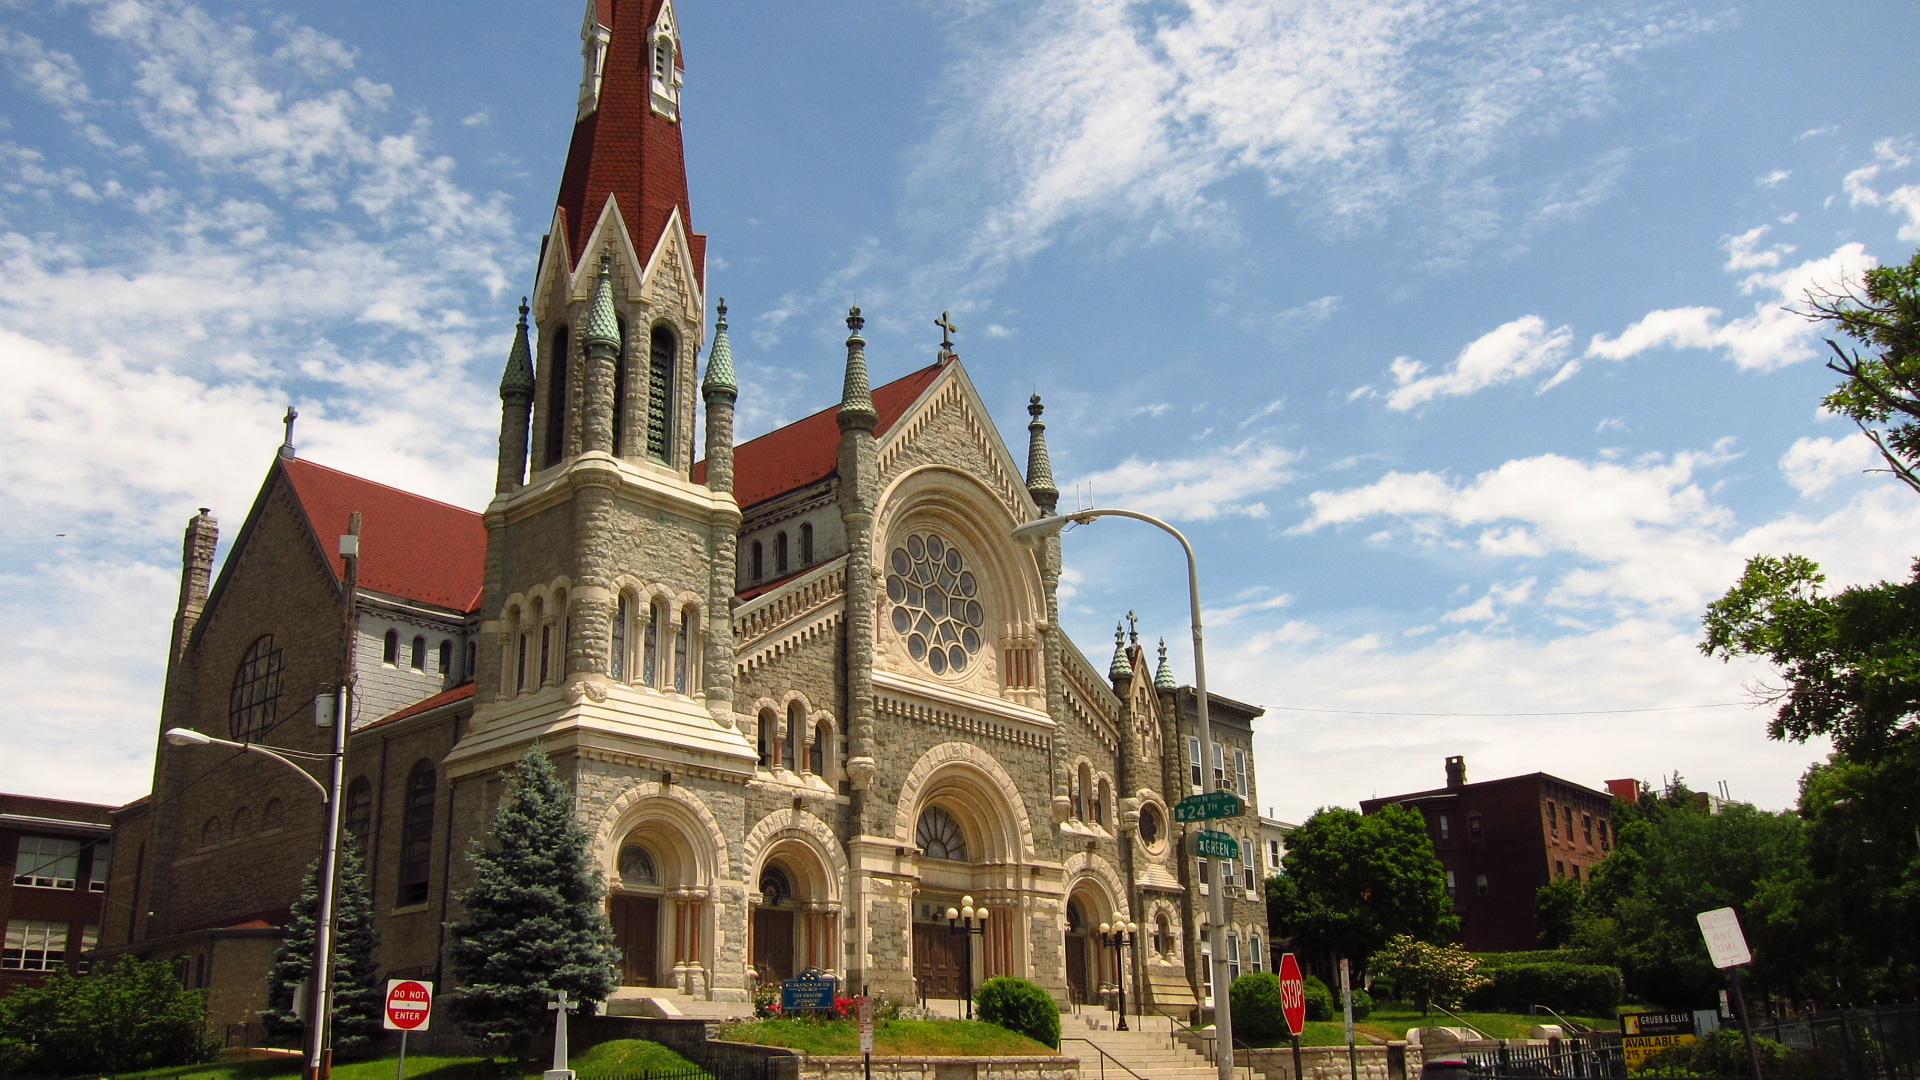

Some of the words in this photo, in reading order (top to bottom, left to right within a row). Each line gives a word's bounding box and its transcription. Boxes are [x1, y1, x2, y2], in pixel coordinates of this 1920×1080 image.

[1187, 803, 1218, 819] 24TH
[1223, 804, 1236, 815] ST
[1205, 839, 1229, 857] GREEN
[1231, 848, 1237, 858] ST
[394, 990, 406, 998] DO
[409, 990, 425, 999] NOT
[1282, 979, 1302, 1009] STOP
[394, 1011, 420, 1020] ENTER
[1640, 1015, 1663, 1025] GRUBB
[1664, 1014, 1670, 1023] &
[1670, 1013, 1689, 1023] ELLIS
[1625, 1036, 1680, 1049] AVAILABLE
